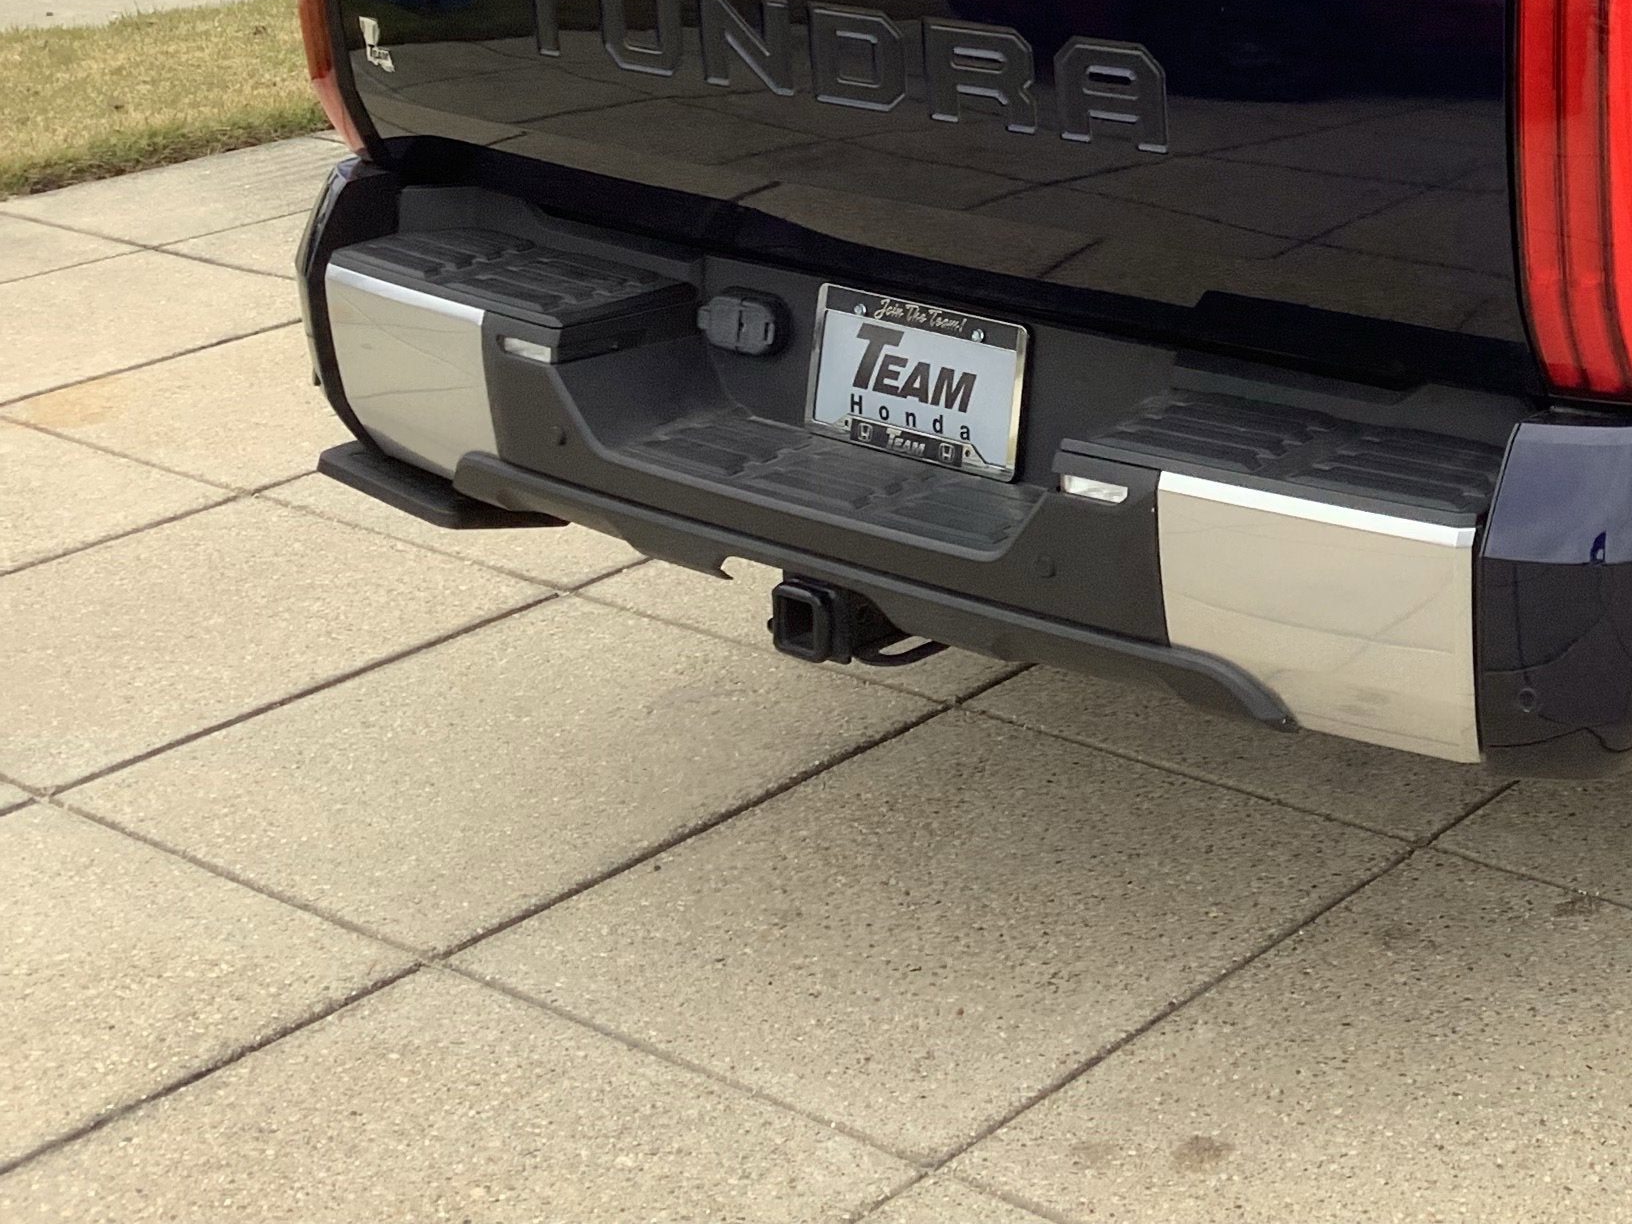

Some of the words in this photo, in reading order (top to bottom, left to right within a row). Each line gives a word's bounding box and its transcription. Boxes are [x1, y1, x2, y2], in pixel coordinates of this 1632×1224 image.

[874, 298, 904, 320] Join
[905, 304, 927, 323] The
[852, 322, 977, 413] TEAM
[886, 427, 926, 456] TEAM
